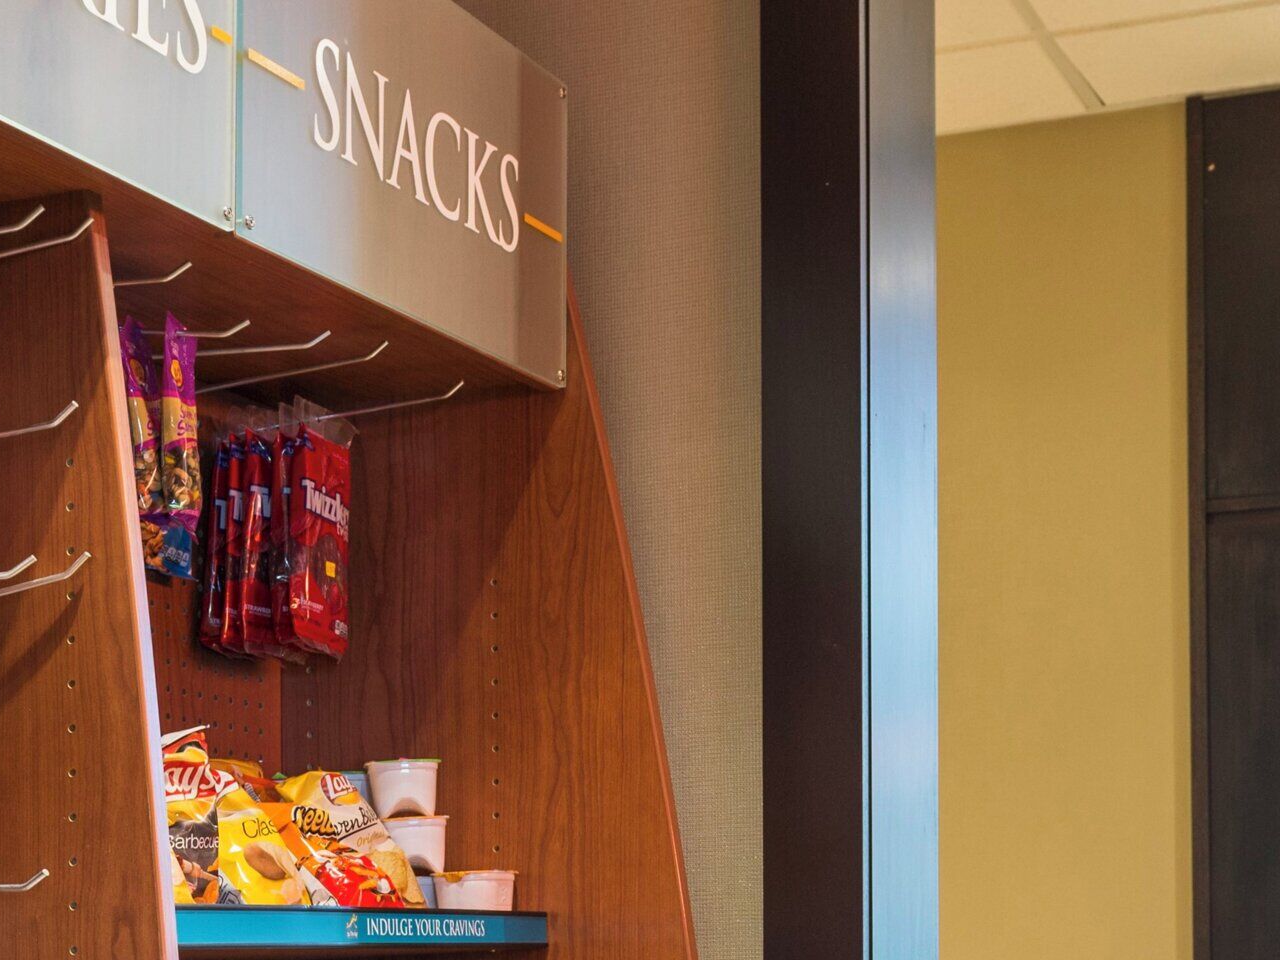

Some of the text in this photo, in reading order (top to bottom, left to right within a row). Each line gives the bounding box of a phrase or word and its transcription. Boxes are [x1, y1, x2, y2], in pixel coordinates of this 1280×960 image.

[313, 38, 520, 253] SNACKS
[366, 917, 413, 936] INDULGE
[414, 918, 442, 937] YOUR
[442, 919, 486, 937] CRAVINGS
